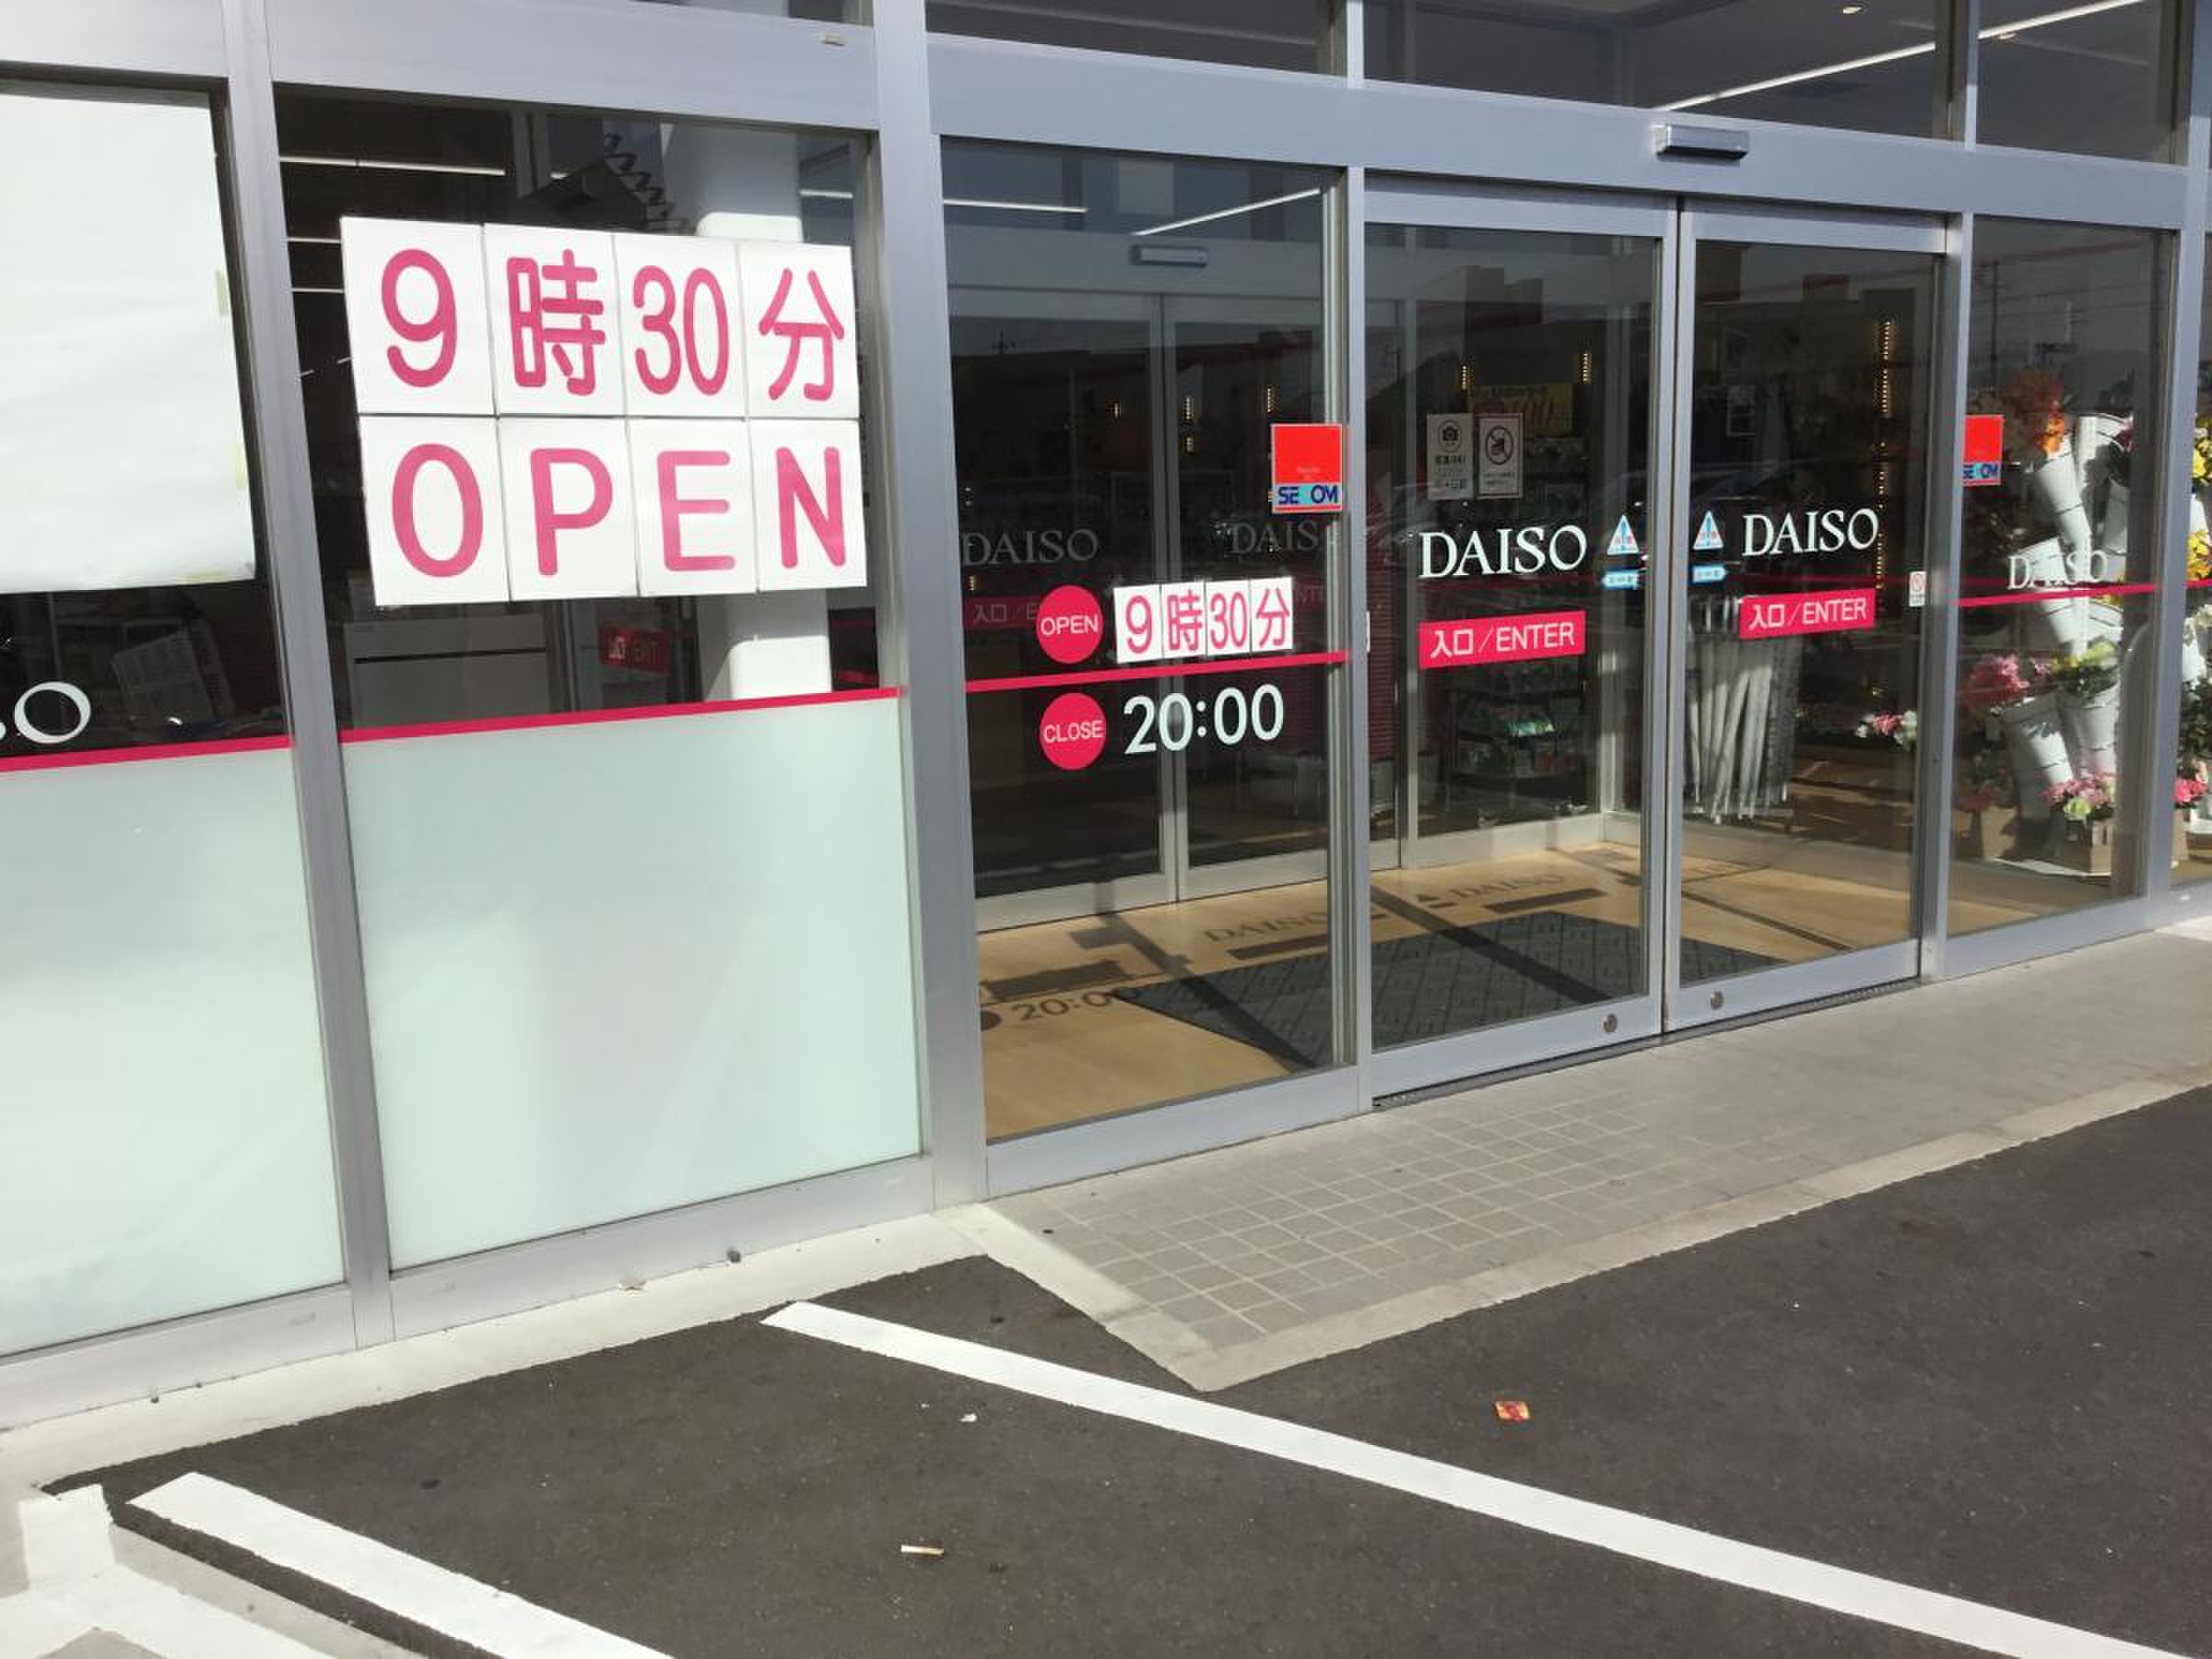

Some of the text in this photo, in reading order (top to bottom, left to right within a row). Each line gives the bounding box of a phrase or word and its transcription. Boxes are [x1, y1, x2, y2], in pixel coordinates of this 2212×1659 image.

[382, 248, 845, 401] 9時30分
[392, 443, 846, 577] OPEN
[1742, 508, 1879, 557] DAISO
[961, 528, 1099, 566] DAISO
[1226, 520, 1327, 558] DAIS
[1418, 524, 1588, 579] DAISO
[1041, 614, 1099, 637] OPEN
[1125, 587, 1290, 653] 9時30分
[0, 681, 91, 744] O
[1043, 720, 1103, 744] CLOSE
[1124, 684, 1285, 755] 20:00
